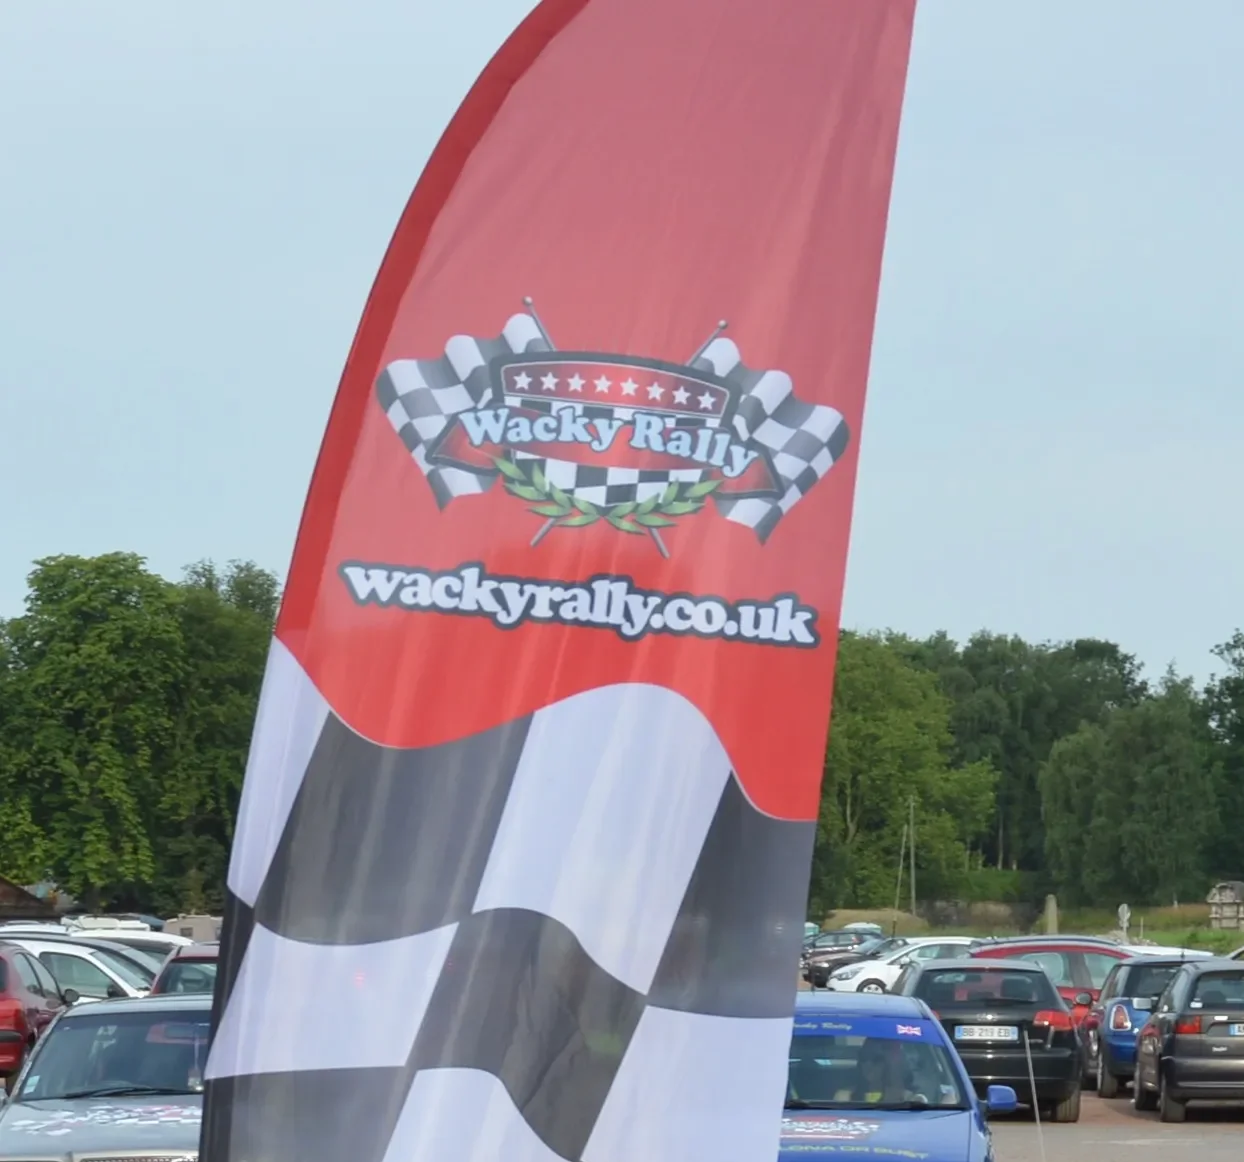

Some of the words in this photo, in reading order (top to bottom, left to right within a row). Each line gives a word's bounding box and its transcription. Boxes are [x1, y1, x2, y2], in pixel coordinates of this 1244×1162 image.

[457, 405, 625, 452] Wacky
[629, 411, 759, 478] Rally
[342, 565, 817, 645] wackyrally.co.uk
